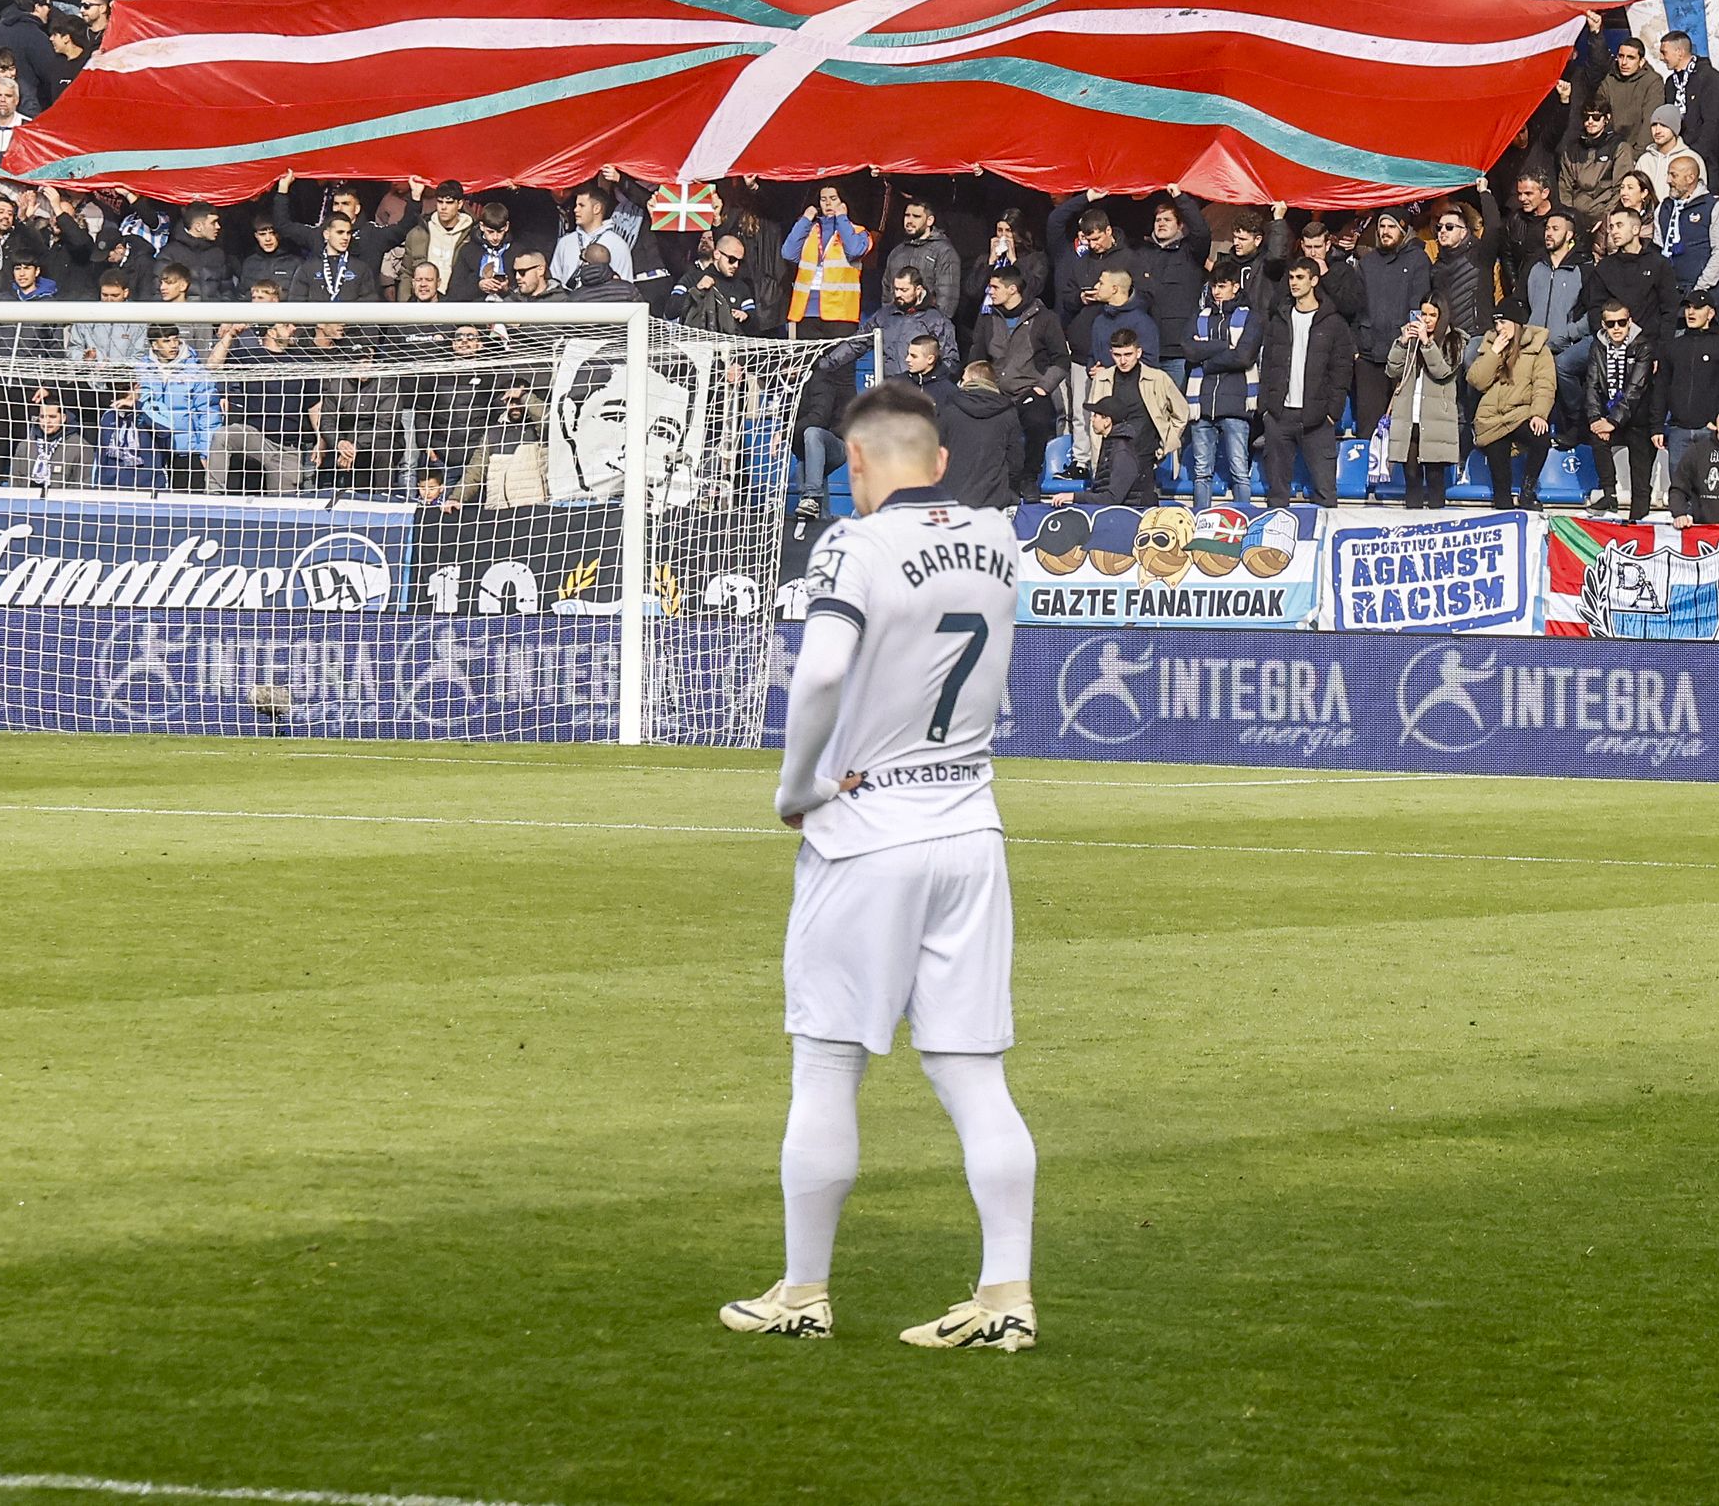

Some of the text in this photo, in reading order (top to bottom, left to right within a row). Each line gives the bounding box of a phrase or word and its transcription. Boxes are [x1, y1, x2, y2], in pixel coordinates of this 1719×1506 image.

[1351, 528, 1503, 557] DEPORTIVO ALAVES
[1351, 544, 1504, 587] AGAINST
[1031, 587, 1287, 618] GAZTE FANATIKOAK
[1351, 575, 1505, 624] RACISM
[926, 612, 990, 744] 7
[1159, 657, 1351, 723] INTEGRA
[1502, 665, 1701, 733] INTEGRA
